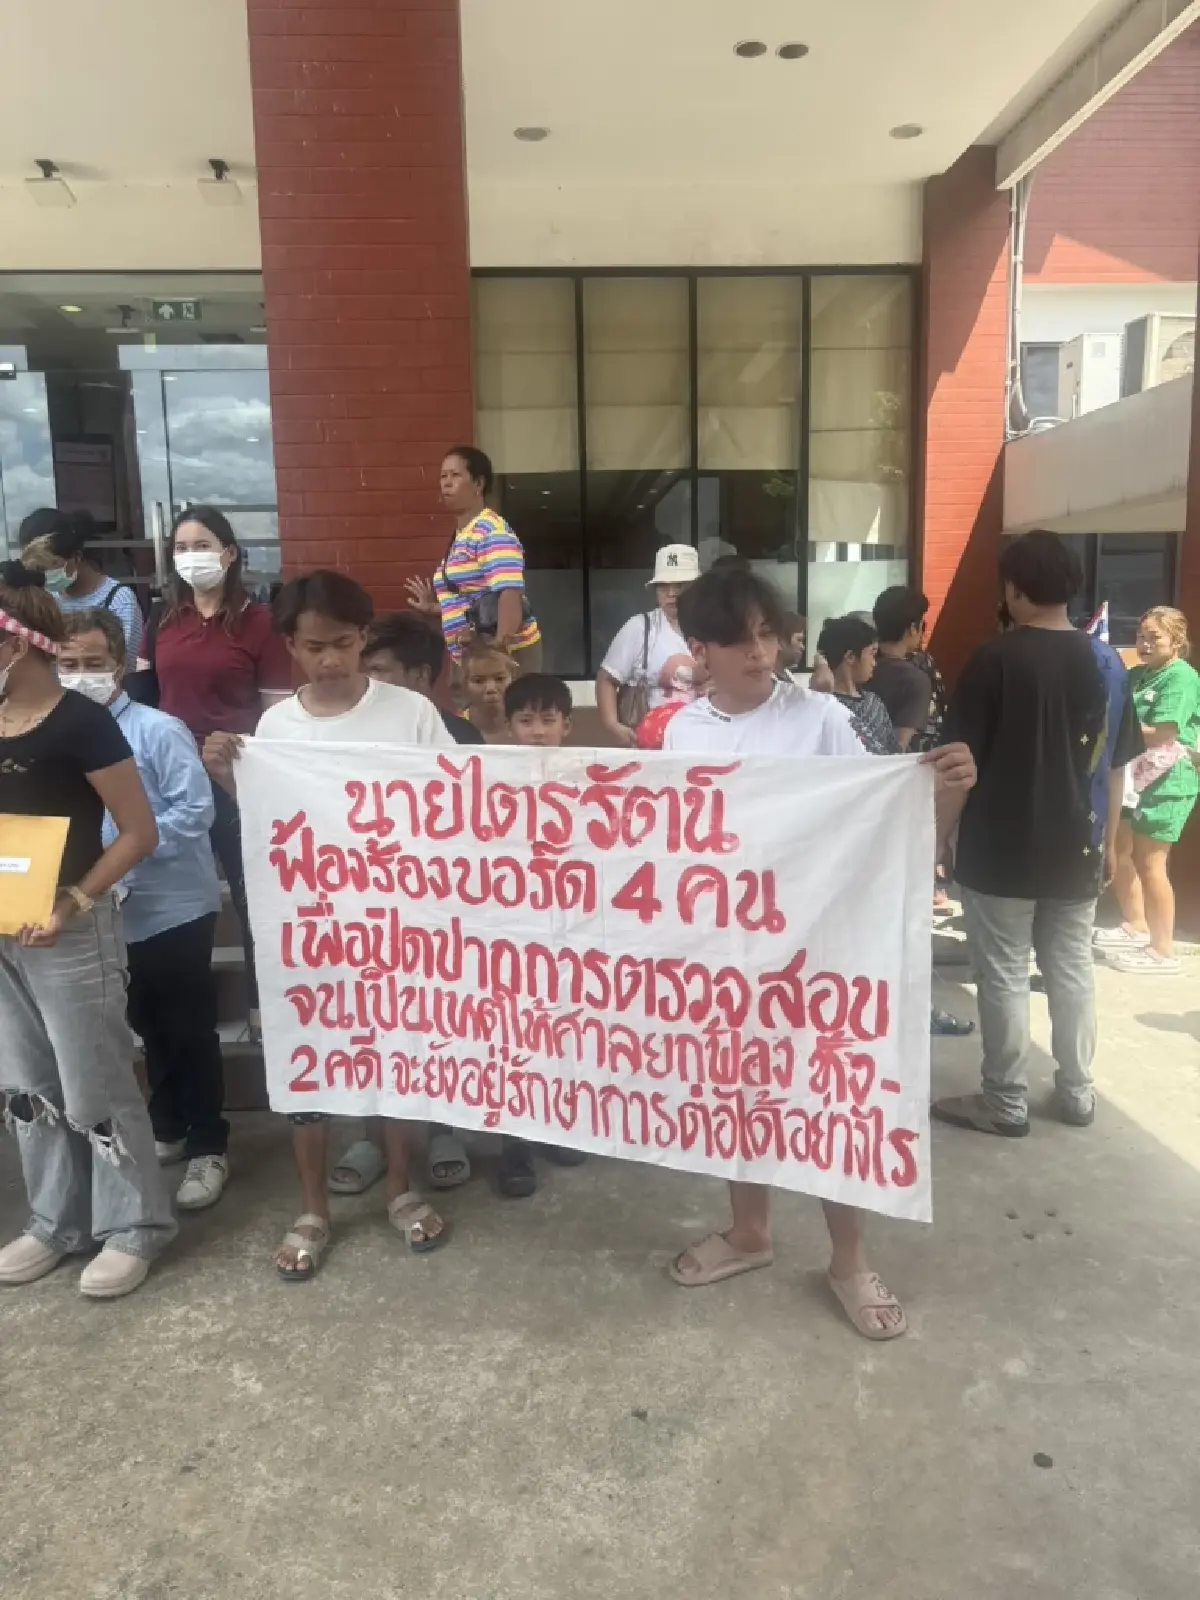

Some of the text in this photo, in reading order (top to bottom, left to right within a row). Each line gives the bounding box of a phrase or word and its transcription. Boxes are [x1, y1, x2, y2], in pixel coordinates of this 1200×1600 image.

[345, 752, 742, 854] นายไตรรัตน์
[611, 861, 664, 925] 4
[677, 863, 787, 935] คน
